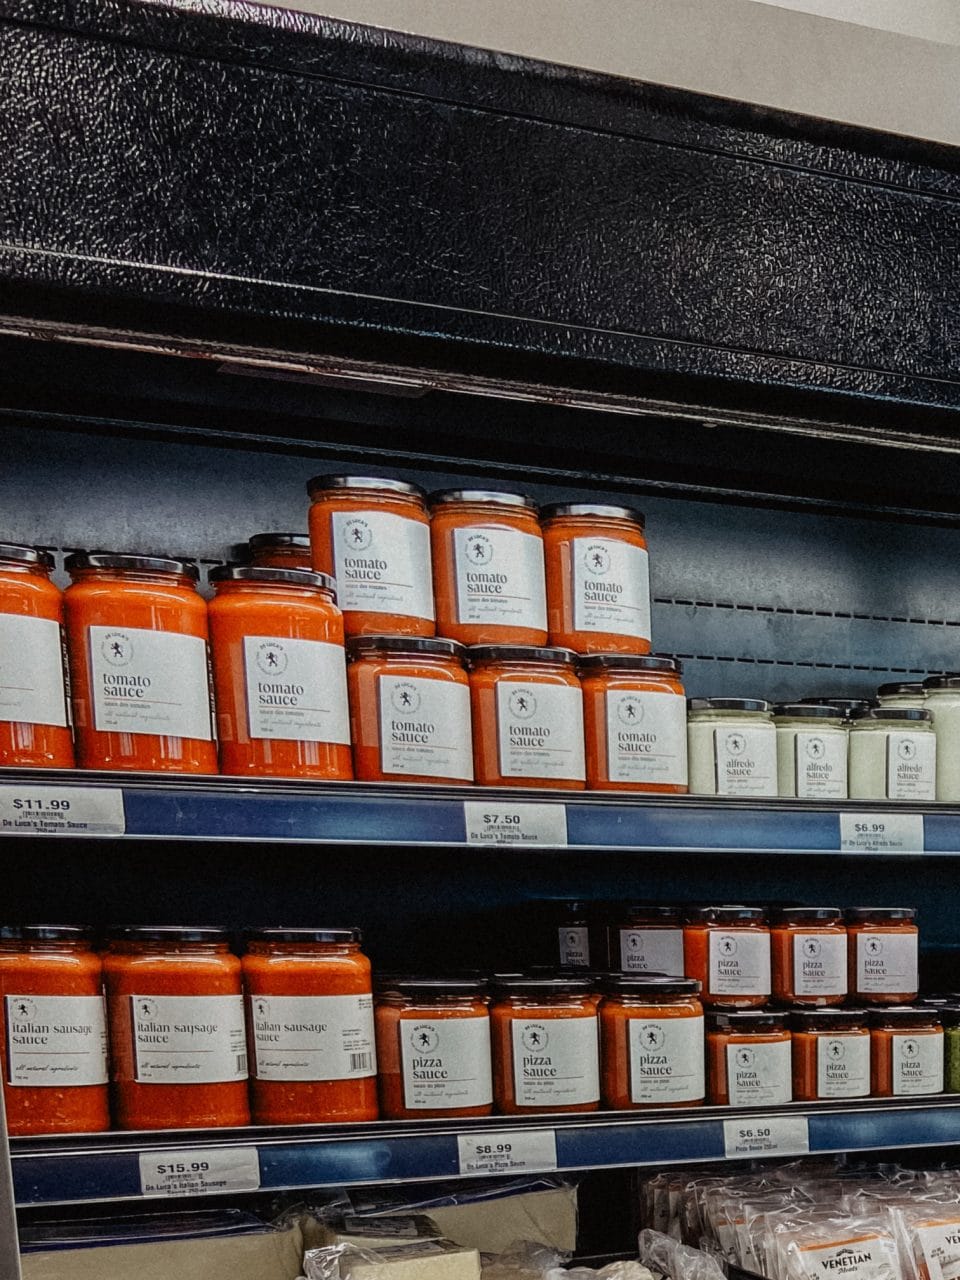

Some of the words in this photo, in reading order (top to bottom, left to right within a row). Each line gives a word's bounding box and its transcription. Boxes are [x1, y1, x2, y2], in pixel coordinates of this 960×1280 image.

[344, 556, 387, 571] tomato
[345, 568, 381, 580] sauce
[466, 571, 507, 585] tomato
[467, 582, 502, 594] sauce
[584, 580, 622, 594] tomato
[584, 591, 617, 603] sauce
[103, 672, 151, 687] tomato
[103, 686, 144, 698] sauce
[258, 682, 304, 696] tomato
[259, 694, 298, 706] sauce
[392, 720, 434, 734] tomato
[509, 725, 550, 738] tomato
[392, 732, 428, 744] sauce
[510, 736, 544, 748] sauce
[618, 732, 656, 744] tomato
[618, 742, 651, 752] sauce
[726, 758, 755, 770] alfredo
[806, 764, 832, 773] alfredo
[898, 764, 922, 773] alfredo
[726, 767, 752, 776] sauce
[806, 771, 829, 780] sauce
[898, 772, 920, 780] sauce
[13, 798, 70, 810] $11.99
[12, 820, 37, 829] Luca's
[483, 814, 520, 825] $7.50
[854, 824, 885, 833] $6.99
[718, 960, 738, 970] pizza
[802, 960, 822, 970] pizza
[864, 959, 884, 968] pizza
[718, 968, 742, 976] sauce
[802, 968, 826, 977] sauce
[864, 967, 888, 976] sauce
[12, 1022, 49, 1036] italian
[54, 1024, 92, 1036] sausage
[138, 1022, 170, 1034] italian
[175, 1023, 218, 1036] sausage
[256, 1022, 280, 1033] italian
[284, 1022, 328, 1035] sausage
[12, 1034, 48, 1046] sauce
[138, 1033, 168, 1044] sauce
[256, 1033, 280, 1042] sauce
[412, 1056, 442, 1070] pizza
[523, 1055, 552, 1070] pizza
[640, 1054, 668, 1069] pizza
[901, 1061, 921, 1071] pizza
[412, 1067, 448, 1080] sauce
[523, 1066, 556, 1078] sauce
[640, 1065, 672, 1076] sauce
[826, 1063, 846, 1073] pizza
[901, 1068, 924, 1077] sauce
[736, 1071, 757, 1082] pizza
[826, 1070, 849, 1079] sauce
[736, 1078, 761, 1088] sauce
[739, 1128, 770, 1138] $6.50
[476, 1144, 512, 1154] $8.99
[157, 1162, 210, 1174] $15.99
[822, 1253, 872, 1270] VENETIAN
